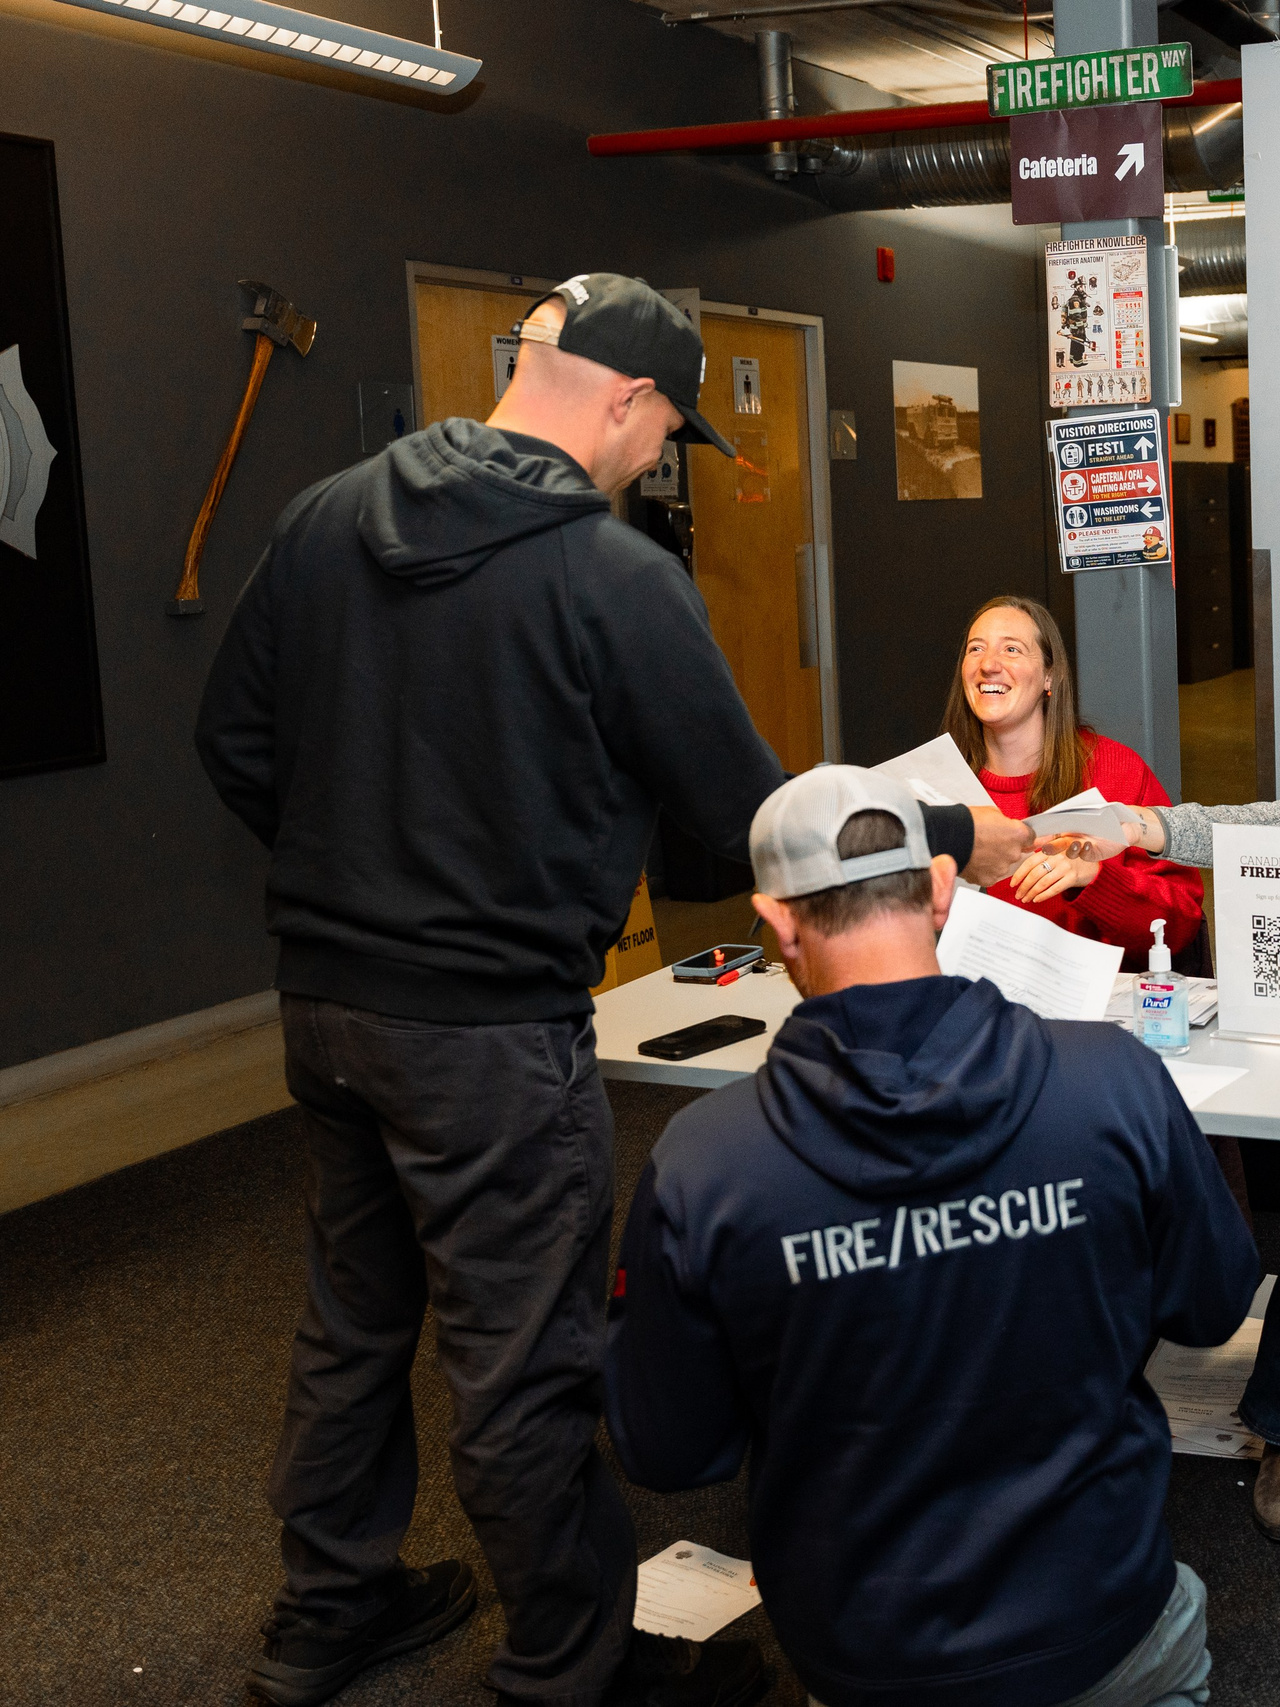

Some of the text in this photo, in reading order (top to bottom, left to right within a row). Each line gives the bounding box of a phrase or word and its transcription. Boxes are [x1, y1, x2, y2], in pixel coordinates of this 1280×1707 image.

[993, 50, 1186, 110] FIREFIGHTER WAY
[1019, 154, 1098, 180] Cafeteria
[1046, 236, 1146, 252] FIREFIGHTER KNOWLEDGE
[1049, 257, 1079, 266] FIREFIGHTER
[1059, 419, 1153, 438] VISITOR DIRECTIONS
[1088, 441, 1124, 456] FESTI
[1091, 471, 1124, 484] CAFETERIA
[1128, 469, 1143, 480] OFAI
[1092, 482, 1136, 494] WAITING AREA
[1093, 504, 1139, 516] WASHROOMS
[616, 926, 655, 953] WET FLOOR
[1145, 998, 1169, 1007] Purell
[781, 1178, 1087, 1285] FIRE/RESCUE
